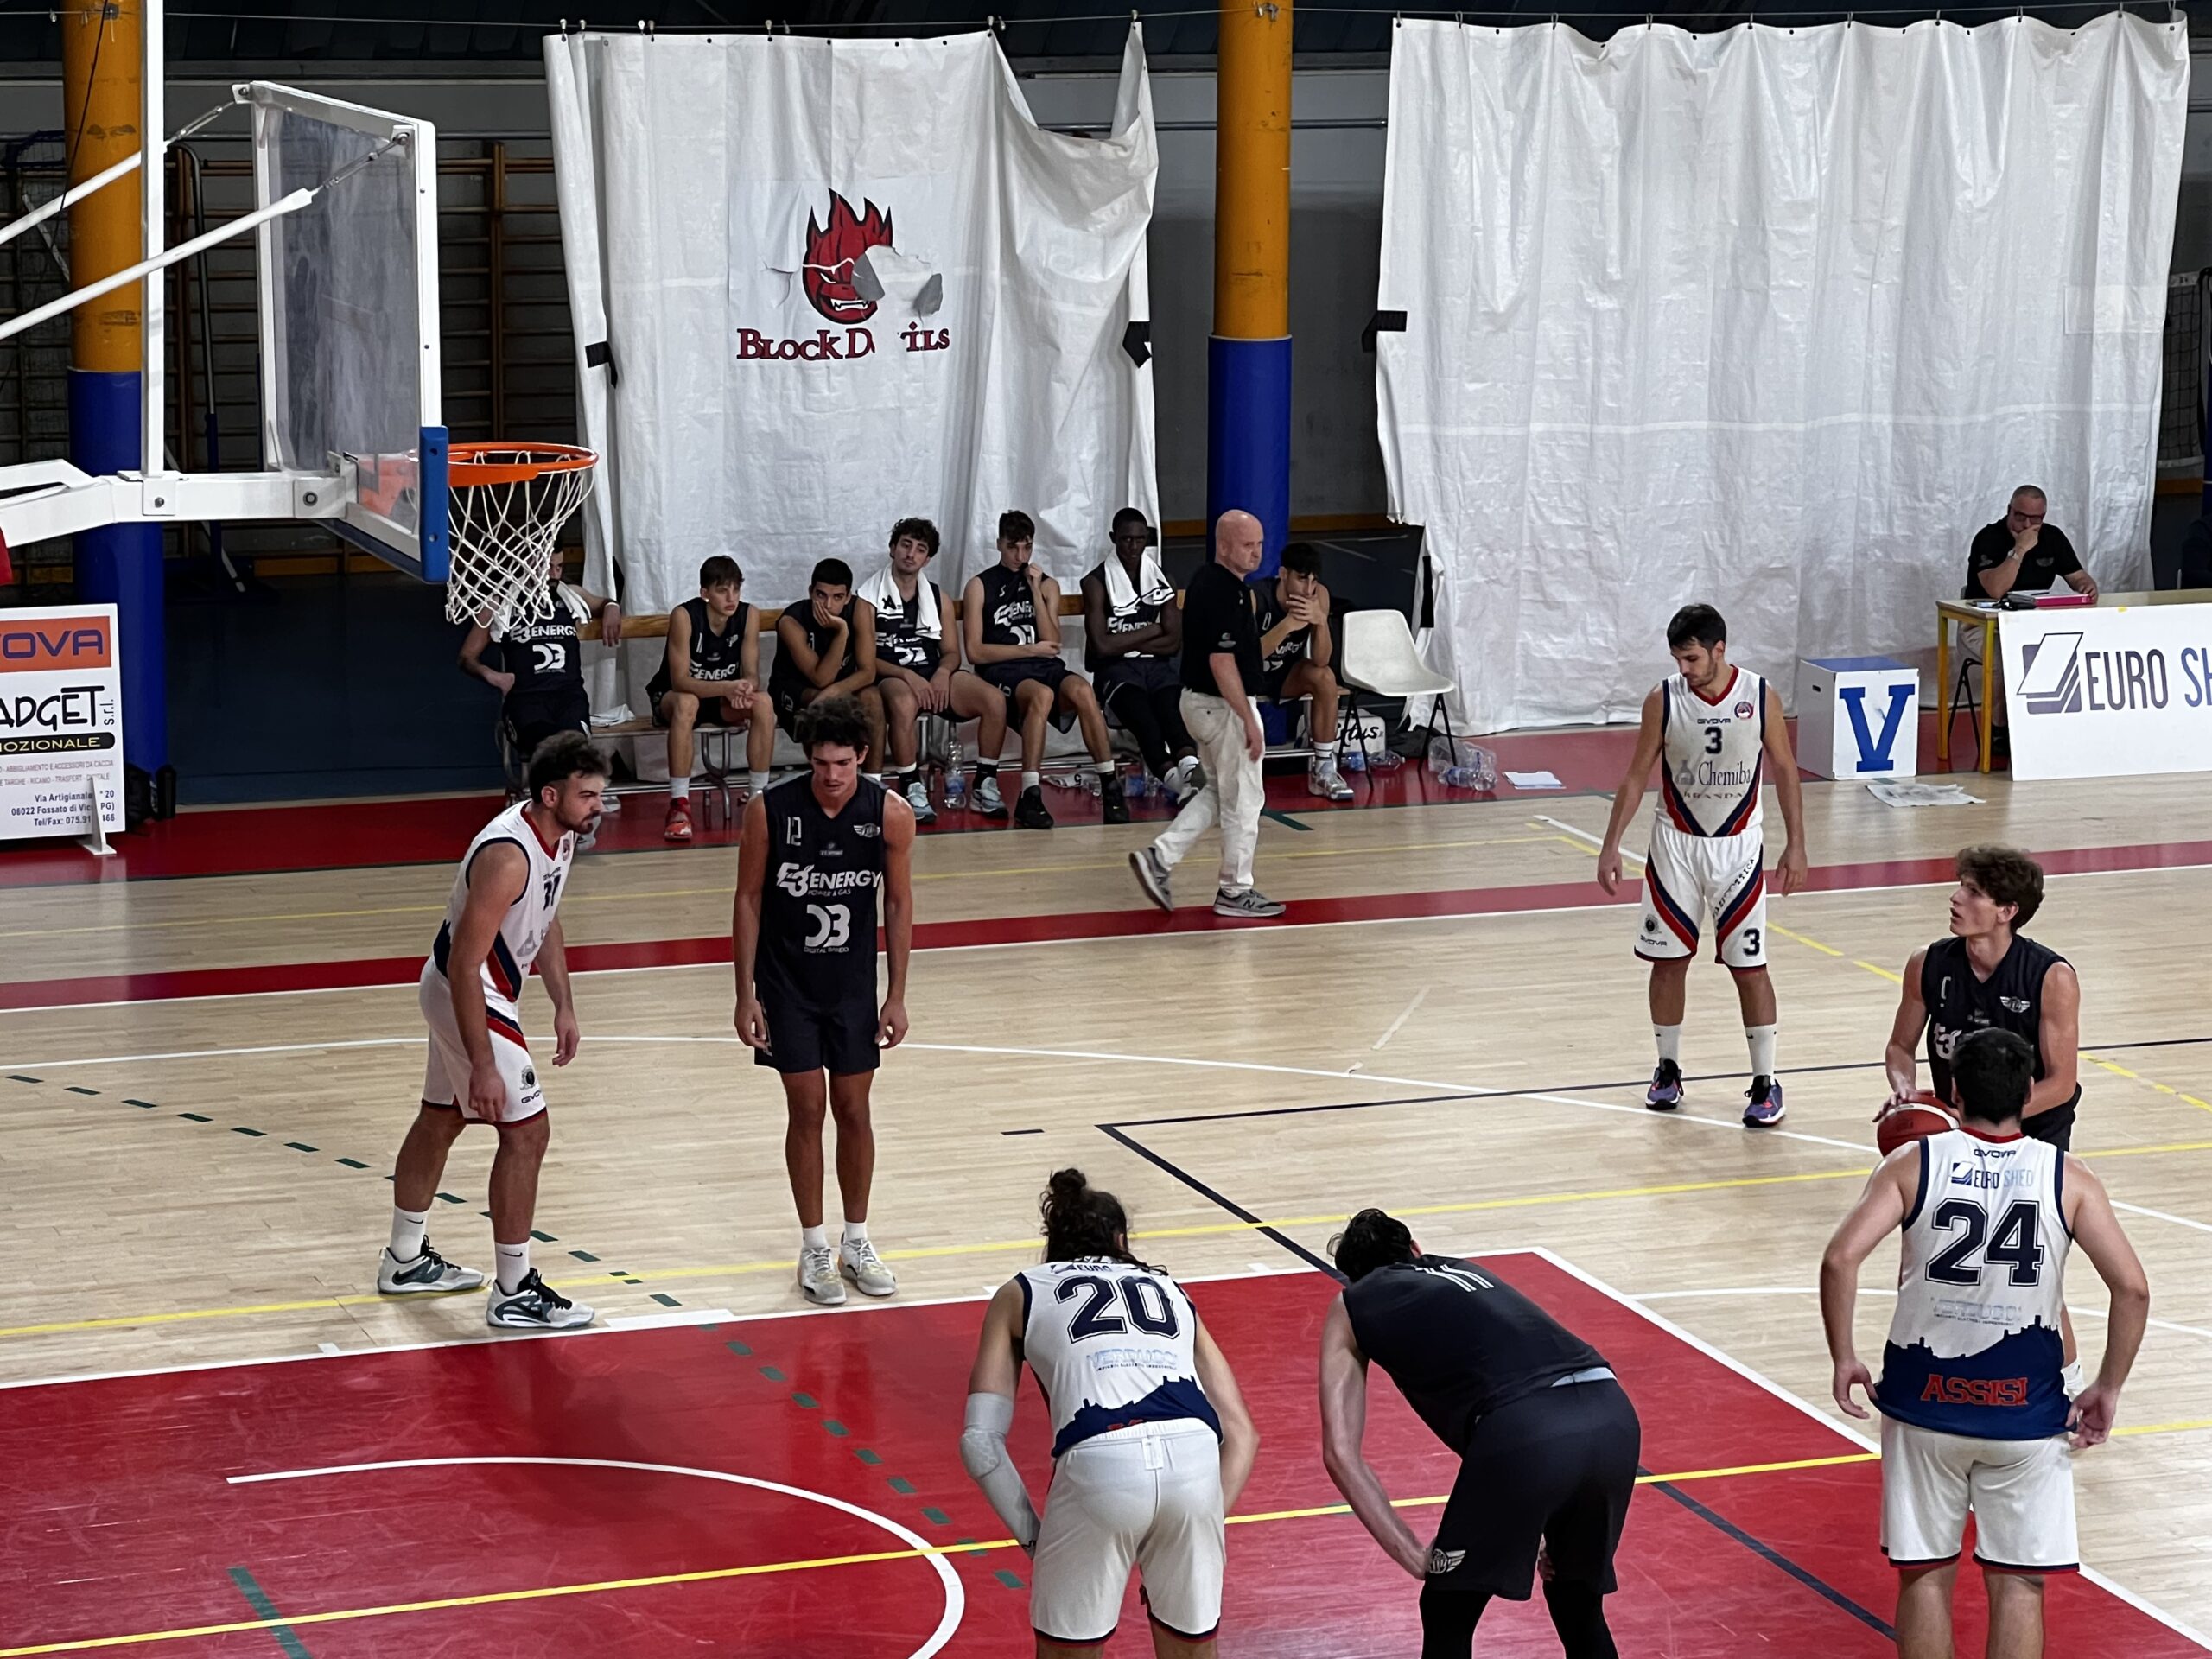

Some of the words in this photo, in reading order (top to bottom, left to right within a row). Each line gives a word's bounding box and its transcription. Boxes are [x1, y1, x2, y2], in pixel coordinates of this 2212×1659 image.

[0, 629, 104, 658] OVA
[2085, 648, 2169, 710] EURO
[1704, 726, 1723, 755] 3
[1839, 683, 1916, 773] V
[0, 737, 101, 753] OZIONALE
[35, 794, 47, 803] Via
[105, 790, 115, 798] 20
[36, 805, 67, 814] Fossato
[69, 804, 78, 812] di
[99, 802, 115, 811] PG)
[786, 816, 802, 847] 12
[810, 869, 882, 889] ENERGY
[1742, 927, 1761, 957] 3
[1974, 1170, 1999, 1189] EURO
[2004, 1169, 2033, 1188] SHED
[1925, 1198, 2045, 1287] 24
[1053, 1274, 1181, 1344] 20
[1920, 1374, 2029, 1406] ASSISI
